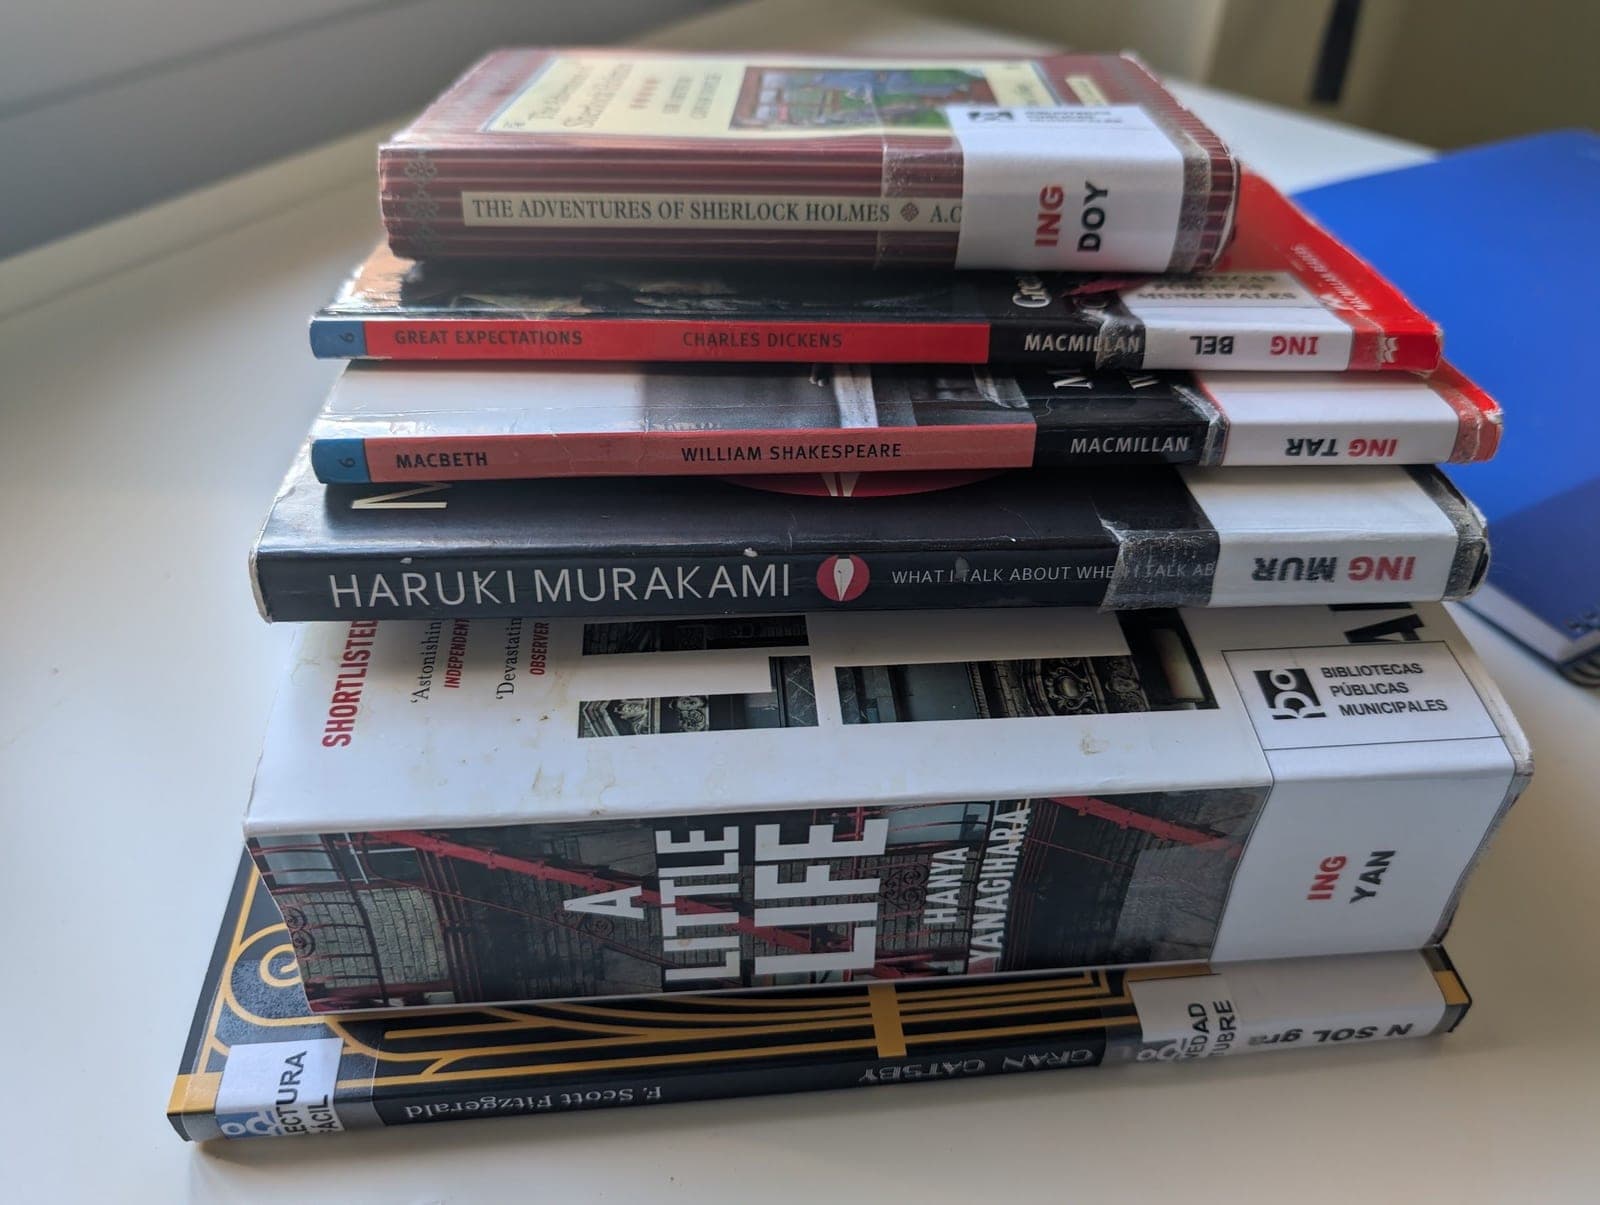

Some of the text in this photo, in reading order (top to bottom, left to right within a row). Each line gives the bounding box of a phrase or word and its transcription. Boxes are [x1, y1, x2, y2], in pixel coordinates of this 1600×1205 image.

[472, 199, 514, 219] THE
[518, 200, 652, 220] ADVENTURES
[658, 201, 684, 220] OF
[690, 202, 801, 222] SHERLOCK
[805, 203, 890, 223] HOLMES
[1034, 185, 1065, 248] ING
[1077, 180, 1109, 252] DOY
[395, 330, 583, 346] GREAT EXPECTATIONS
[683, 331, 843, 349] CHARLES DICKENS
[1024, 333, 1140, 352] MACMILLAN
[1189, 335, 1319, 356] ING BEL
[681, 443, 902, 462] WILLIAM SHAKESPEARE
[1070, 436, 1190, 453] MACMILLAN
[1284, 438, 1398, 457] ING TAR
[396, 451, 488, 469] MACBETH
[891, 569, 945, 584] WHAT
[1009, 566, 1072, 581] ABOUT
[1251, 556, 1416, 583] ING MUR
[329, 562, 790, 608] HARUKI MURAKAMI
[530, 621, 550, 676] OBSERVER
[1321, 662, 1424, 679] BIBLIOTECAS
[1329, 681, 1410, 697] PÚBLICAS
[1338, 699, 1448, 717] MUNICIPALES
[923, 846, 970, 924] HANYA
[968, 806, 1032, 964] YANAGIHARA
[1306, 855, 1347, 900] ING
[1349, 849, 1397, 904] YAN
[563, 885, 645, 920] A
[655, 825, 740, 981] LITTLE
[754, 818, 890, 975] LIFE
[1312, 1025, 1378, 1042] SOL
[1384, 1023, 1414, 1037] N
[858, 1049, 1093, 1083] GRAN GATSBY
[275, 1050, 308, 1134] ECTURA
[404, 1086, 663, 1119] F. Scott Fitzgerald
